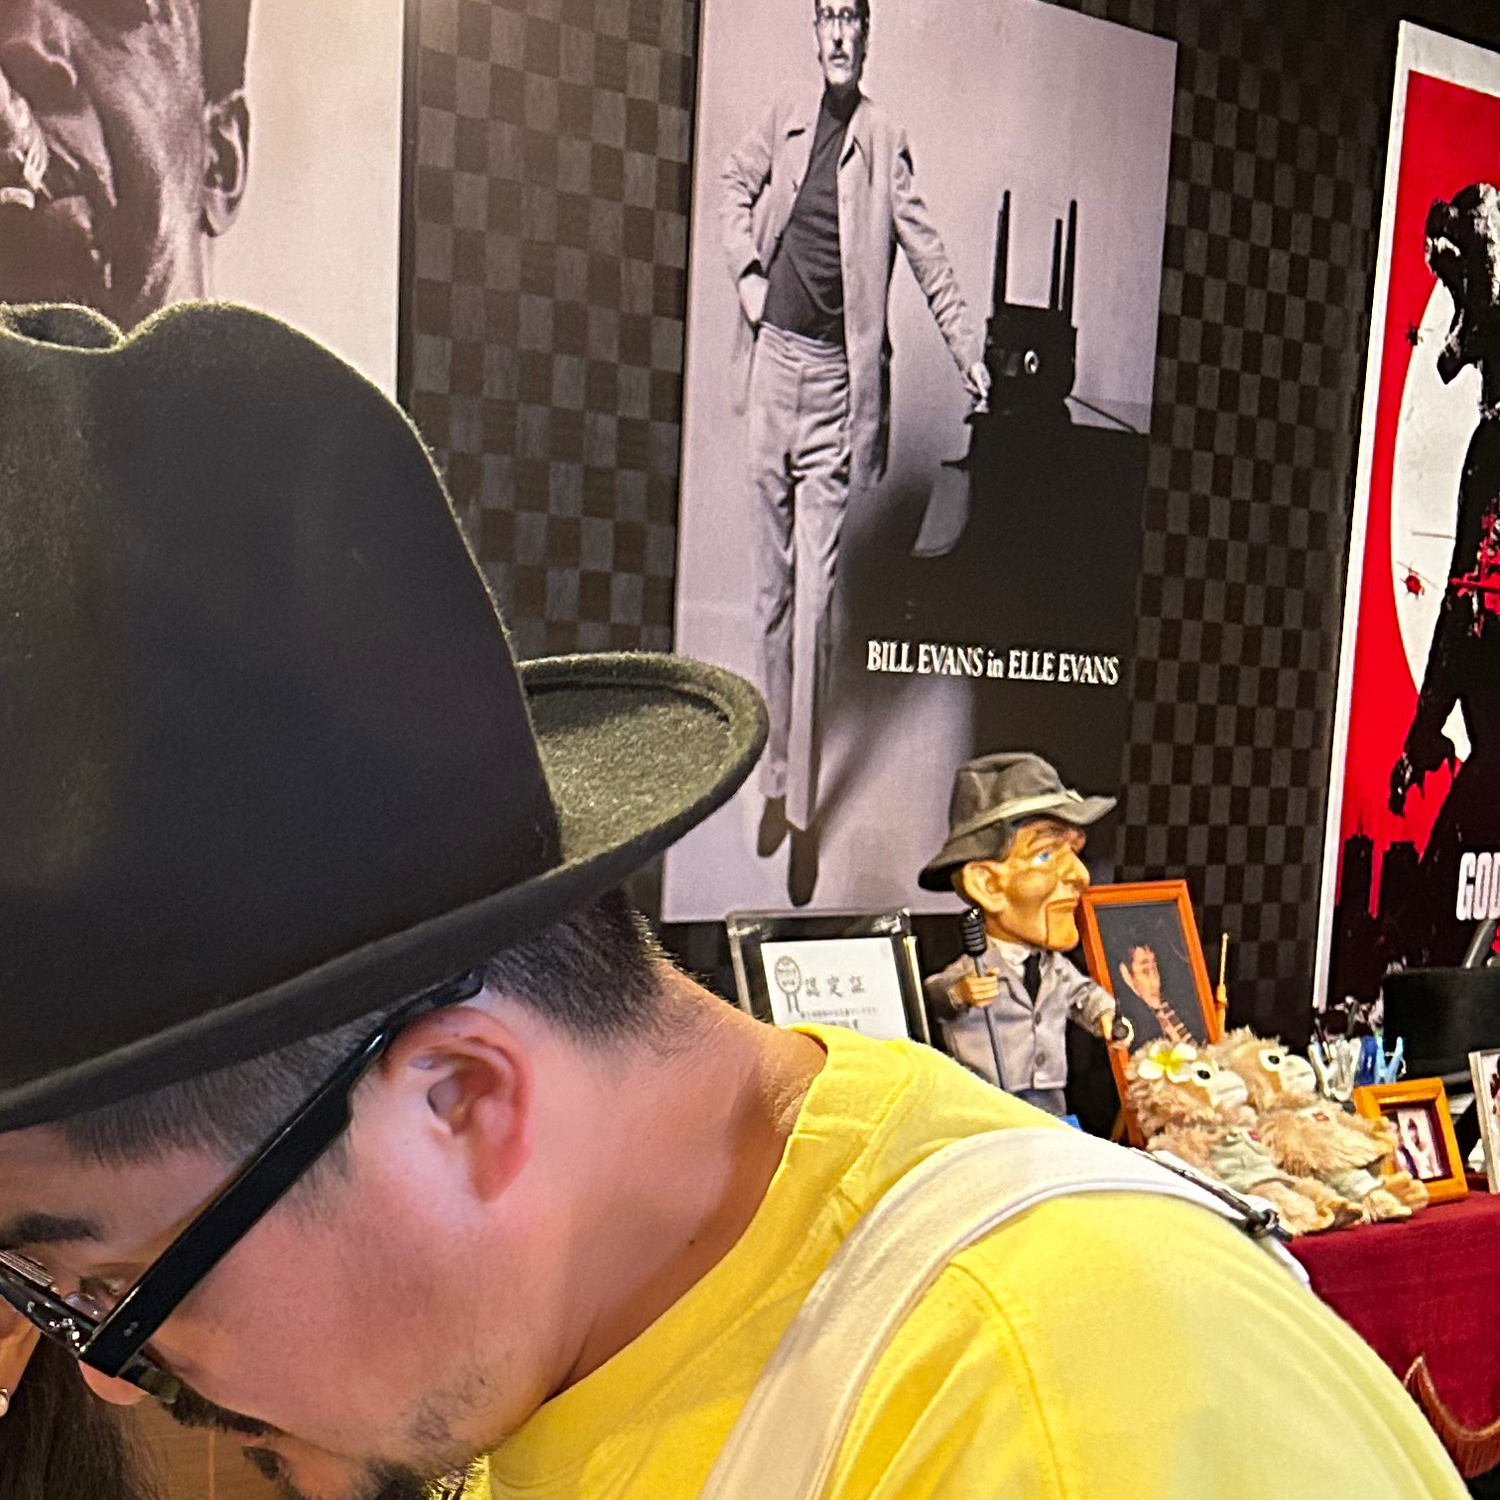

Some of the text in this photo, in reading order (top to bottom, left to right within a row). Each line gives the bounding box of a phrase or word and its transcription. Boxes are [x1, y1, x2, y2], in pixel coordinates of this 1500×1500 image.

[866, 640, 1120, 686] BILL EVANS in ELLE EVANS
